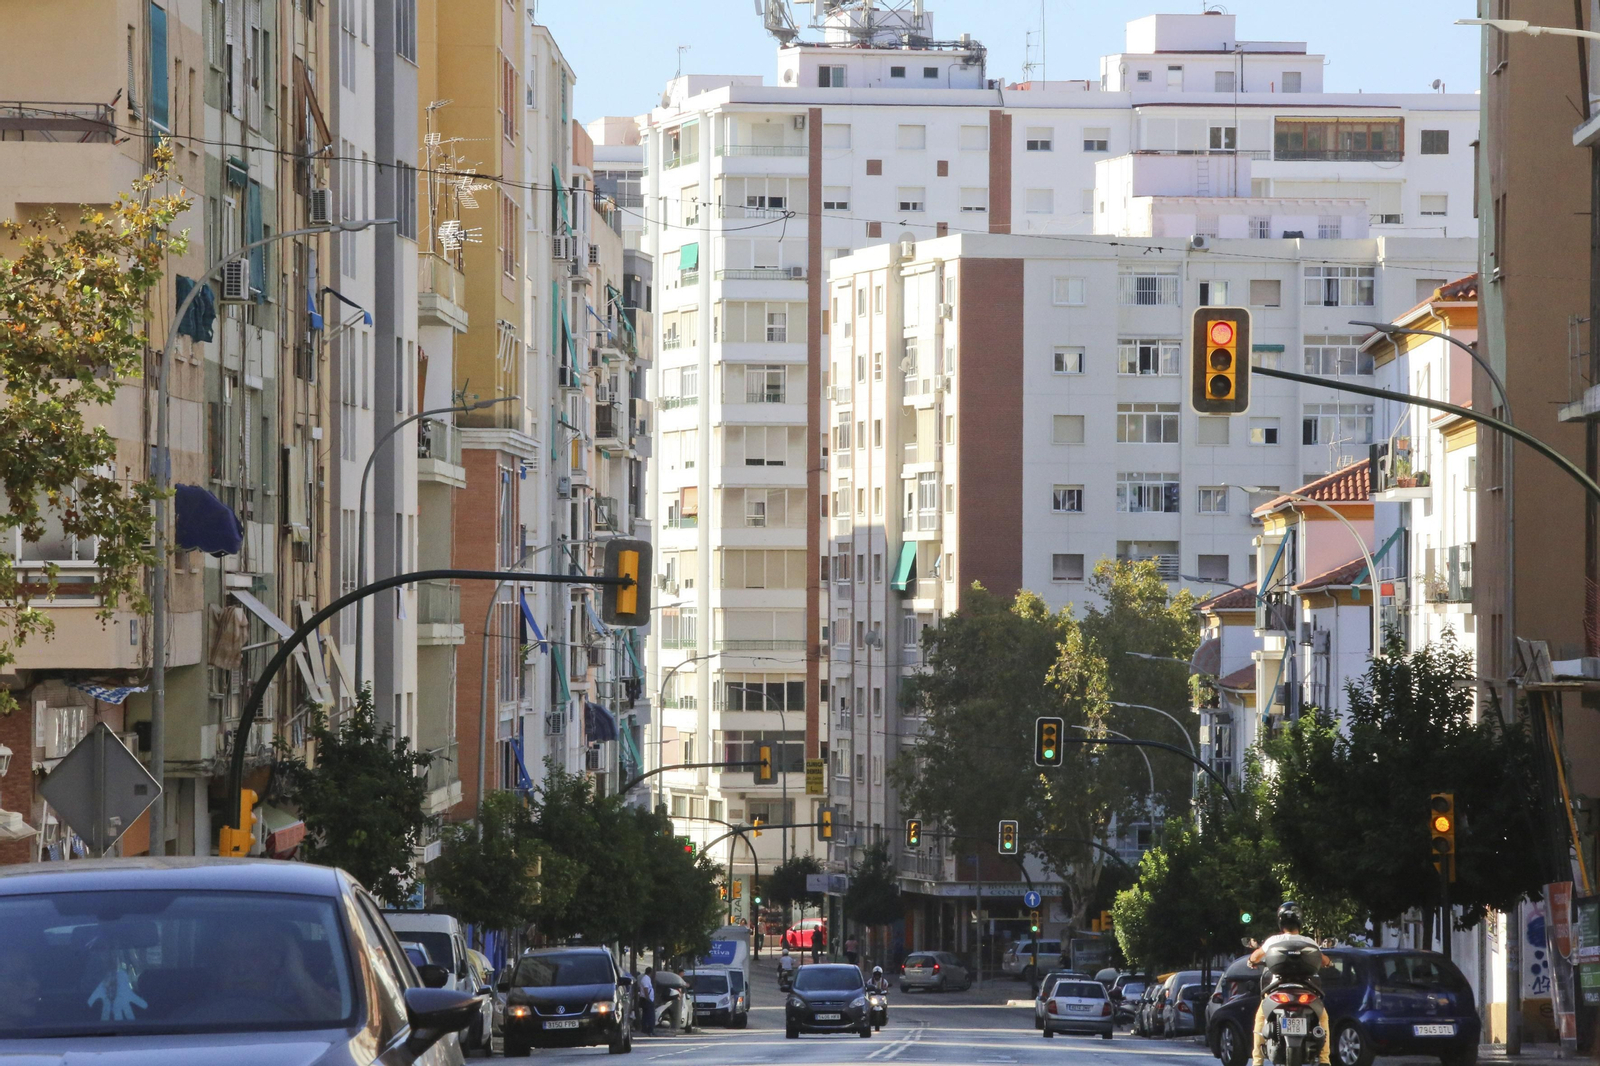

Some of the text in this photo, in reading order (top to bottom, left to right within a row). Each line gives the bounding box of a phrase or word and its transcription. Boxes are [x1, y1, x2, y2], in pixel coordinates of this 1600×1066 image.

[1287, 1018, 1304, 1026] 3631
[1419, 1026, 1452, 1034] 7945 DTL
